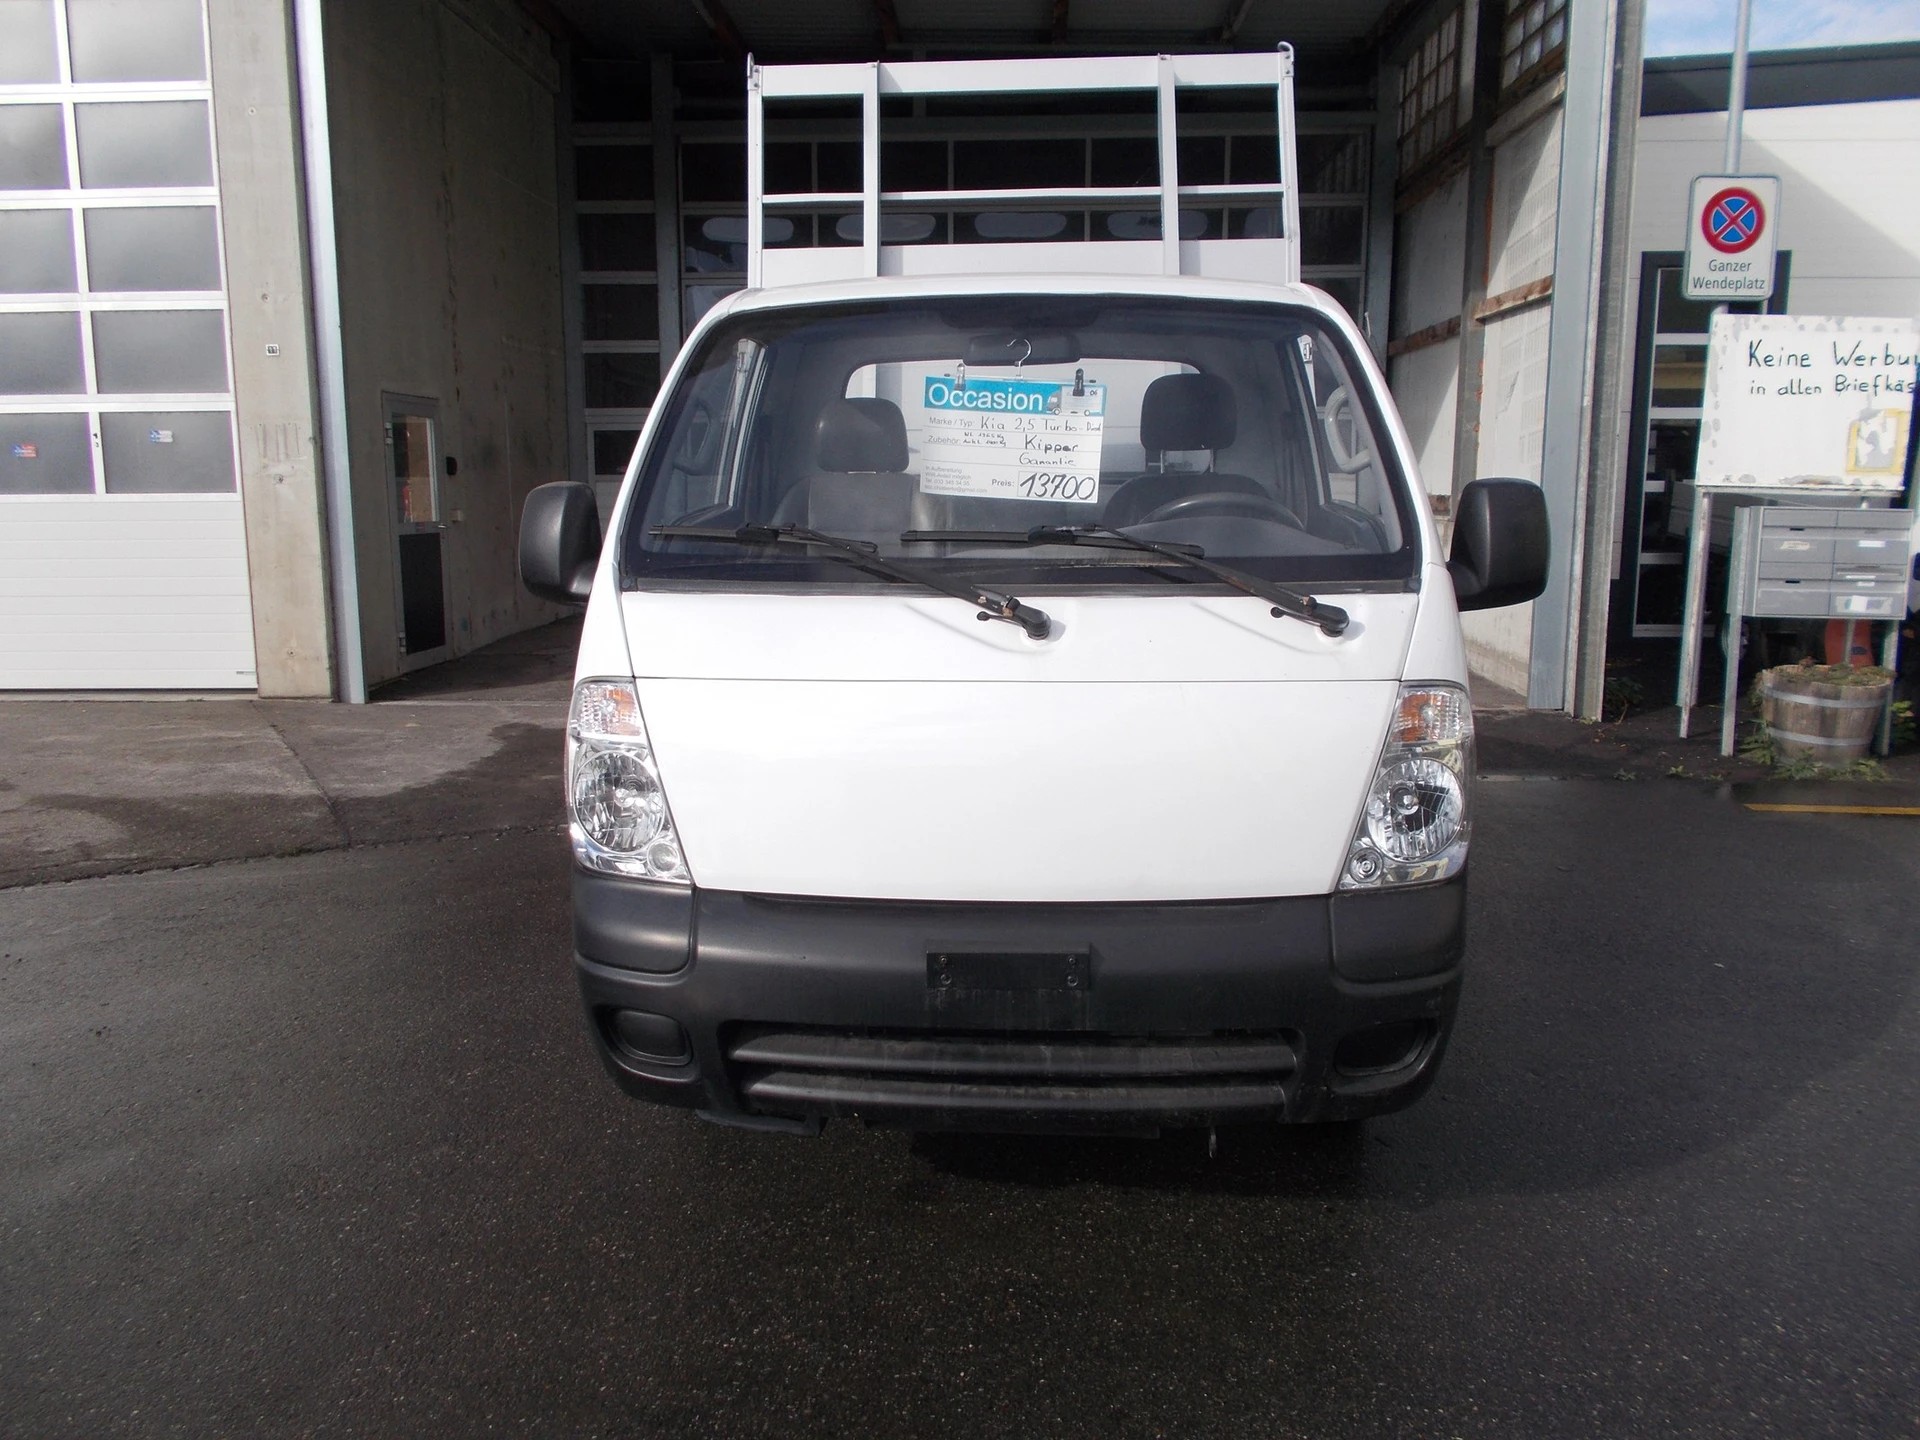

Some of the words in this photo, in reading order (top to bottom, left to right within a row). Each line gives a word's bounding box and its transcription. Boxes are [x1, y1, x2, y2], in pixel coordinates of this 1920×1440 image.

[1708, 259, 1752, 272] Ganzer
[1692, 276, 1766, 292] Wendeplatz
[1748, 339, 1812, 368] Keine
[1749, 379, 1766, 395] in
[1777, 378, 1821, 395] allen
[928, 382, 1043, 412] Occasion
[929, 416, 952, 426] Marke
[980, 415, 1005, 431] Kia
[1014, 417, 1035, 432] 2,5
[1024, 434, 1080, 454] Kipper
[991, 478, 1015, 488] Preis:
[1019, 472, 1097, 501] 13700
